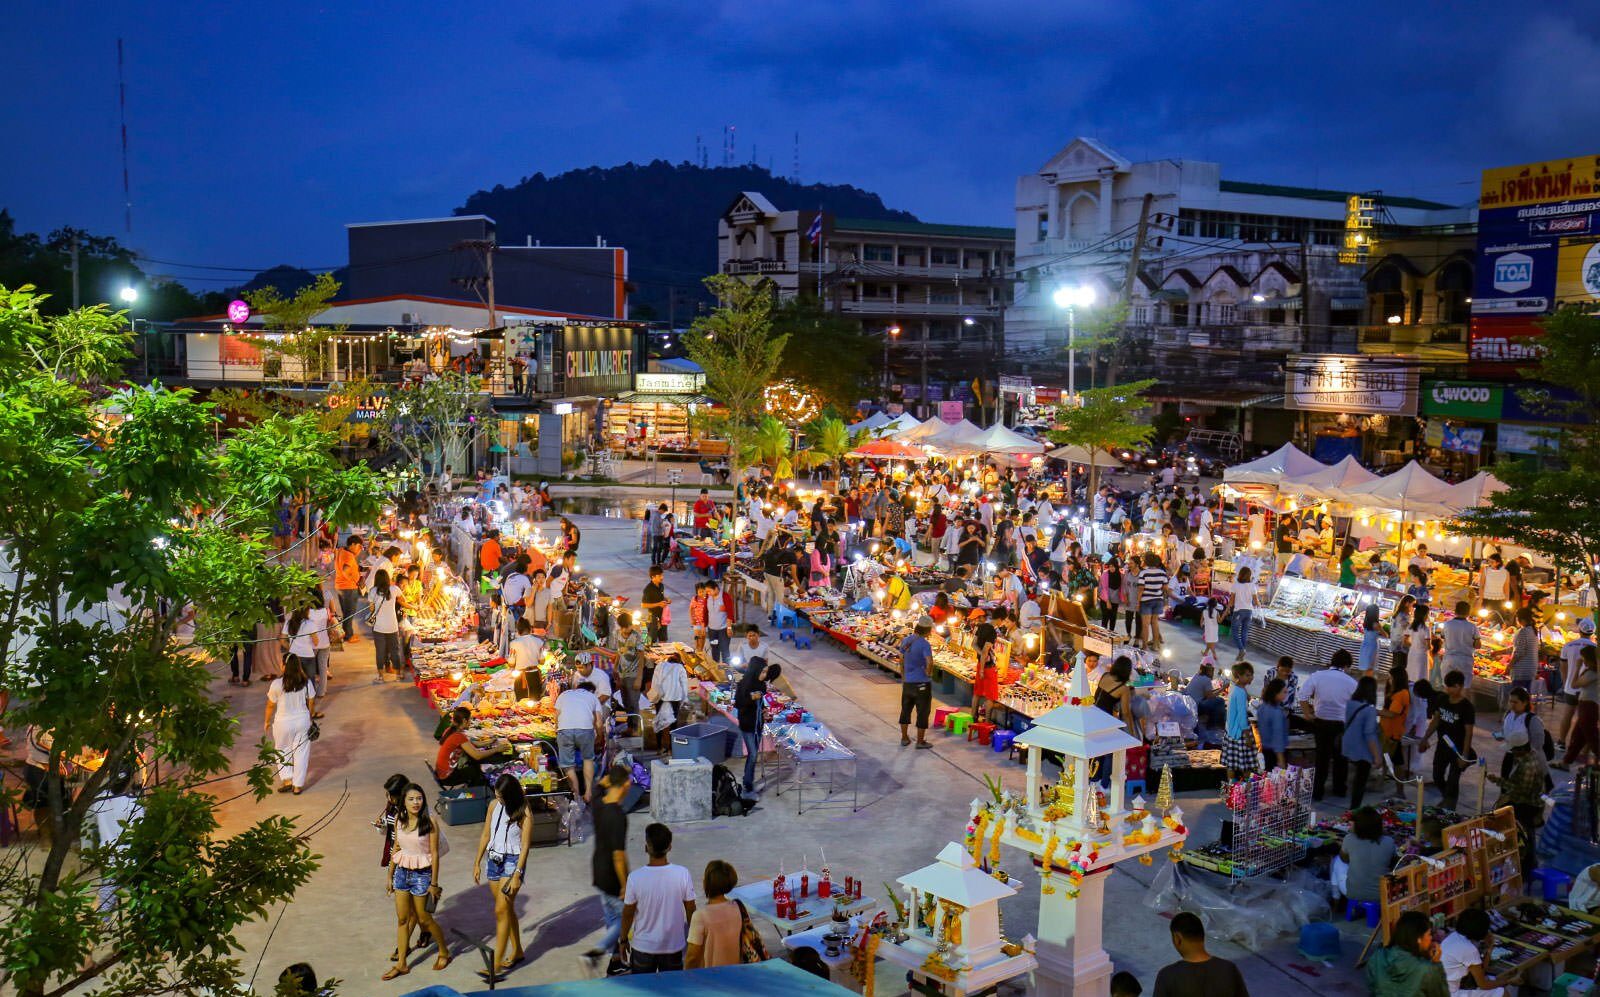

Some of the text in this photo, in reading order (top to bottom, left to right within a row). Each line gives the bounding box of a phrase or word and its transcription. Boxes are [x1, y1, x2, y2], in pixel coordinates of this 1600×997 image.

[1497, 265, 1529, 281] TOA
[566, 350, 632, 378] CHILLVA MARKET
[639, 378, 692, 389] Jasmine
